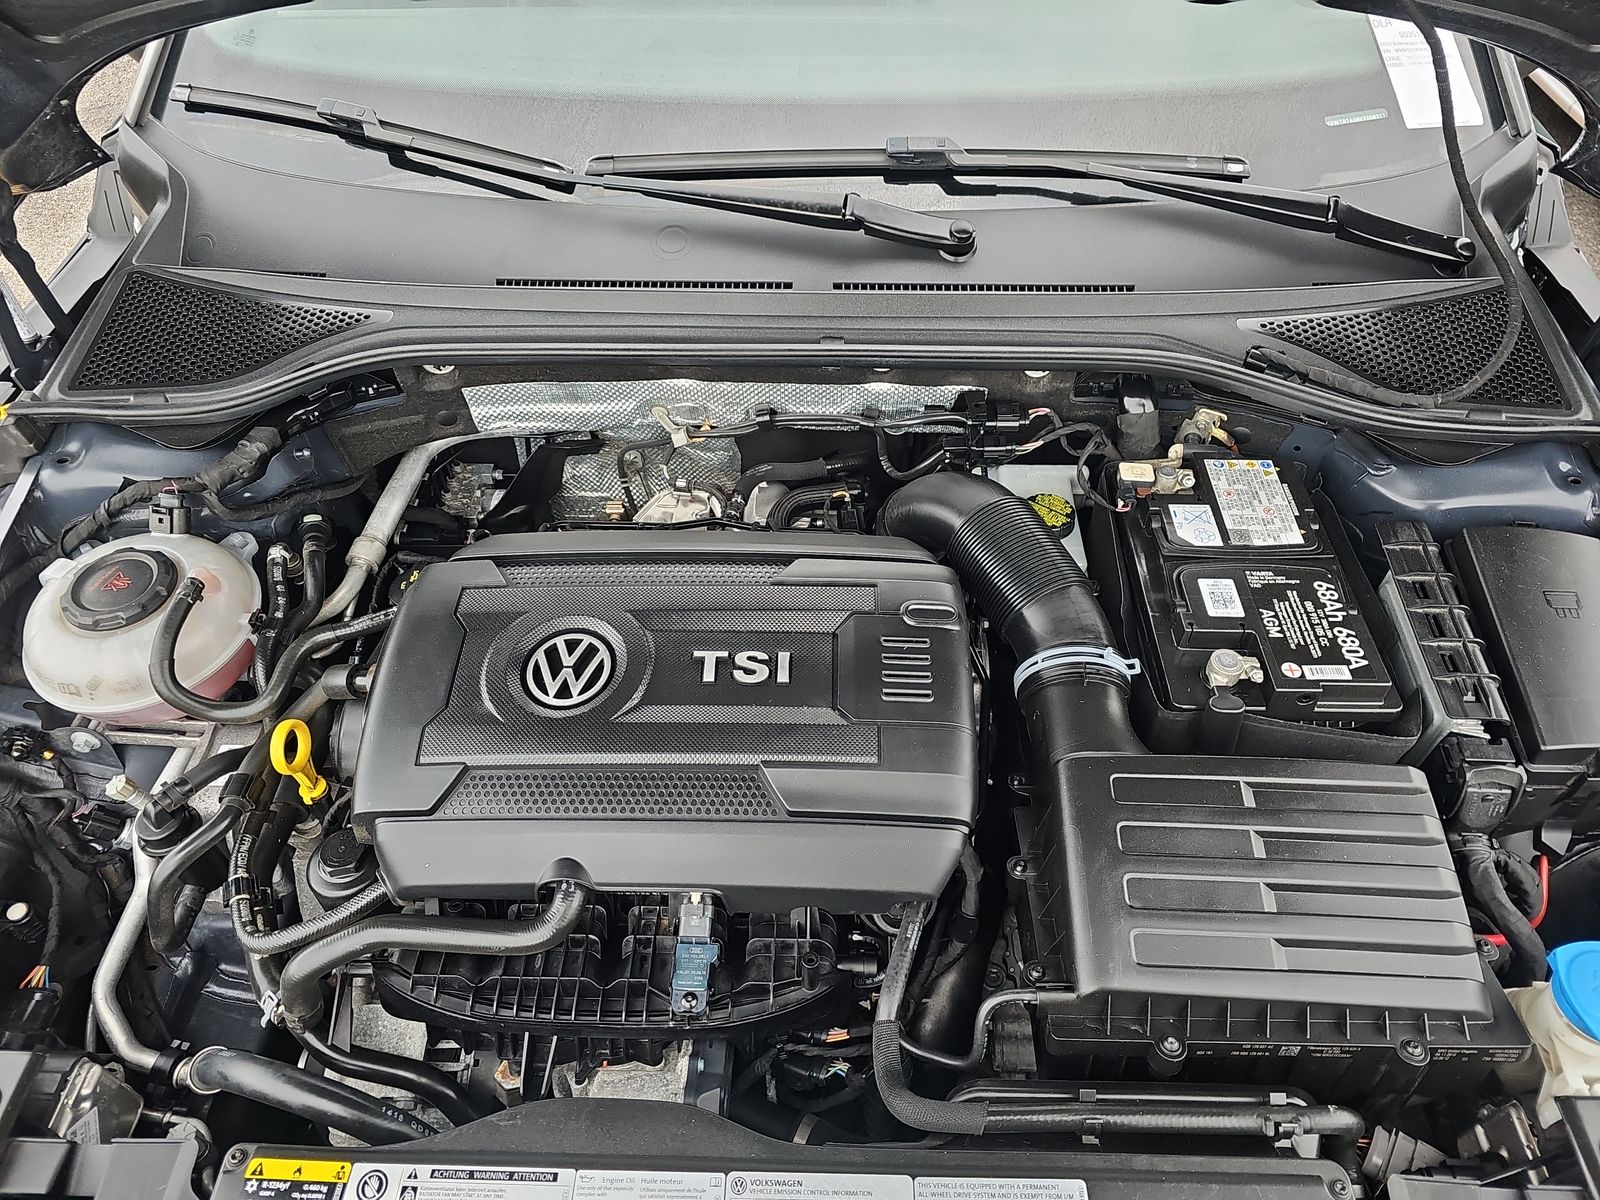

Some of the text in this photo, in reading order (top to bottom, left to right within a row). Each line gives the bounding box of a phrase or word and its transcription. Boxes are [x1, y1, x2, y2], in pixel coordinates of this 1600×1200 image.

[1259, 608, 1284, 638] AGM
[1313, 580, 1369, 670] 68Ah 680A
[692, 650, 793, 685] TSI
[432, 1170, 554, 1182] ACHTUNG WARNING ATTENTION
[602, 1177, 624, 1186] Engine
[750, 1178, 803, 1188] VOLKSWAGEN
